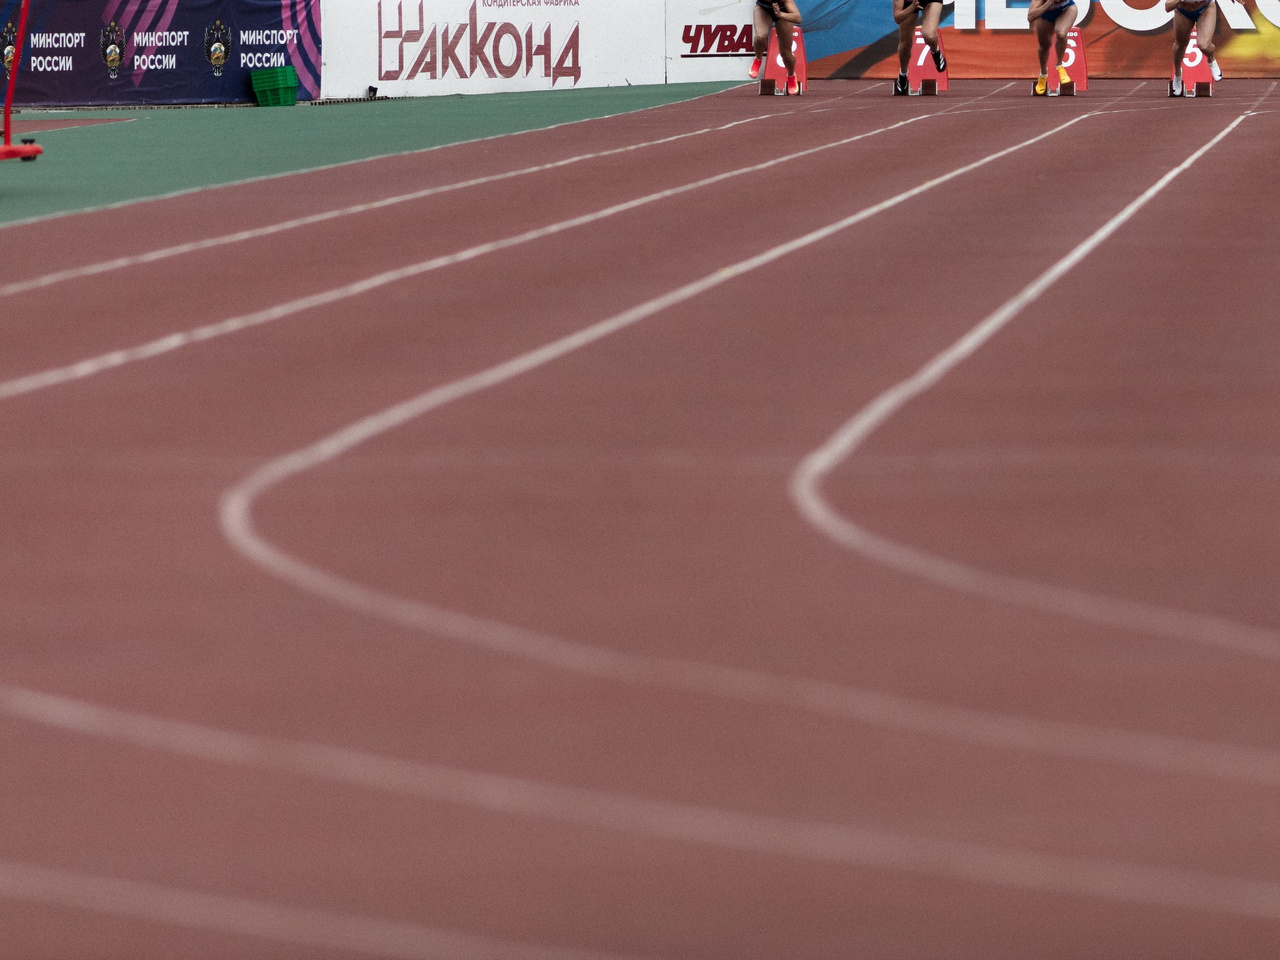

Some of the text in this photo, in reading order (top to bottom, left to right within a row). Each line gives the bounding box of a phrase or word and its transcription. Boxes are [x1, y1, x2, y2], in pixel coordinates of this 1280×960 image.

[30, 32, 86, 48] МИНСПОРТ
[133, 31, 189, 47] МИНСПОРТ
[240, 29, 299, 45] МИНСПОРТ
[682, 24, 767, 53] ЧУВА
[240, 51, 286, 68] РОССИИ
[916, 37, 931, 66] 7
[1062, 39, 1077, 68] 6
[1183, 39, 1204, 68] 5
[30, 56, 73, 72] РОССИИ
[133, 54, 176, 70] РОССИИ
